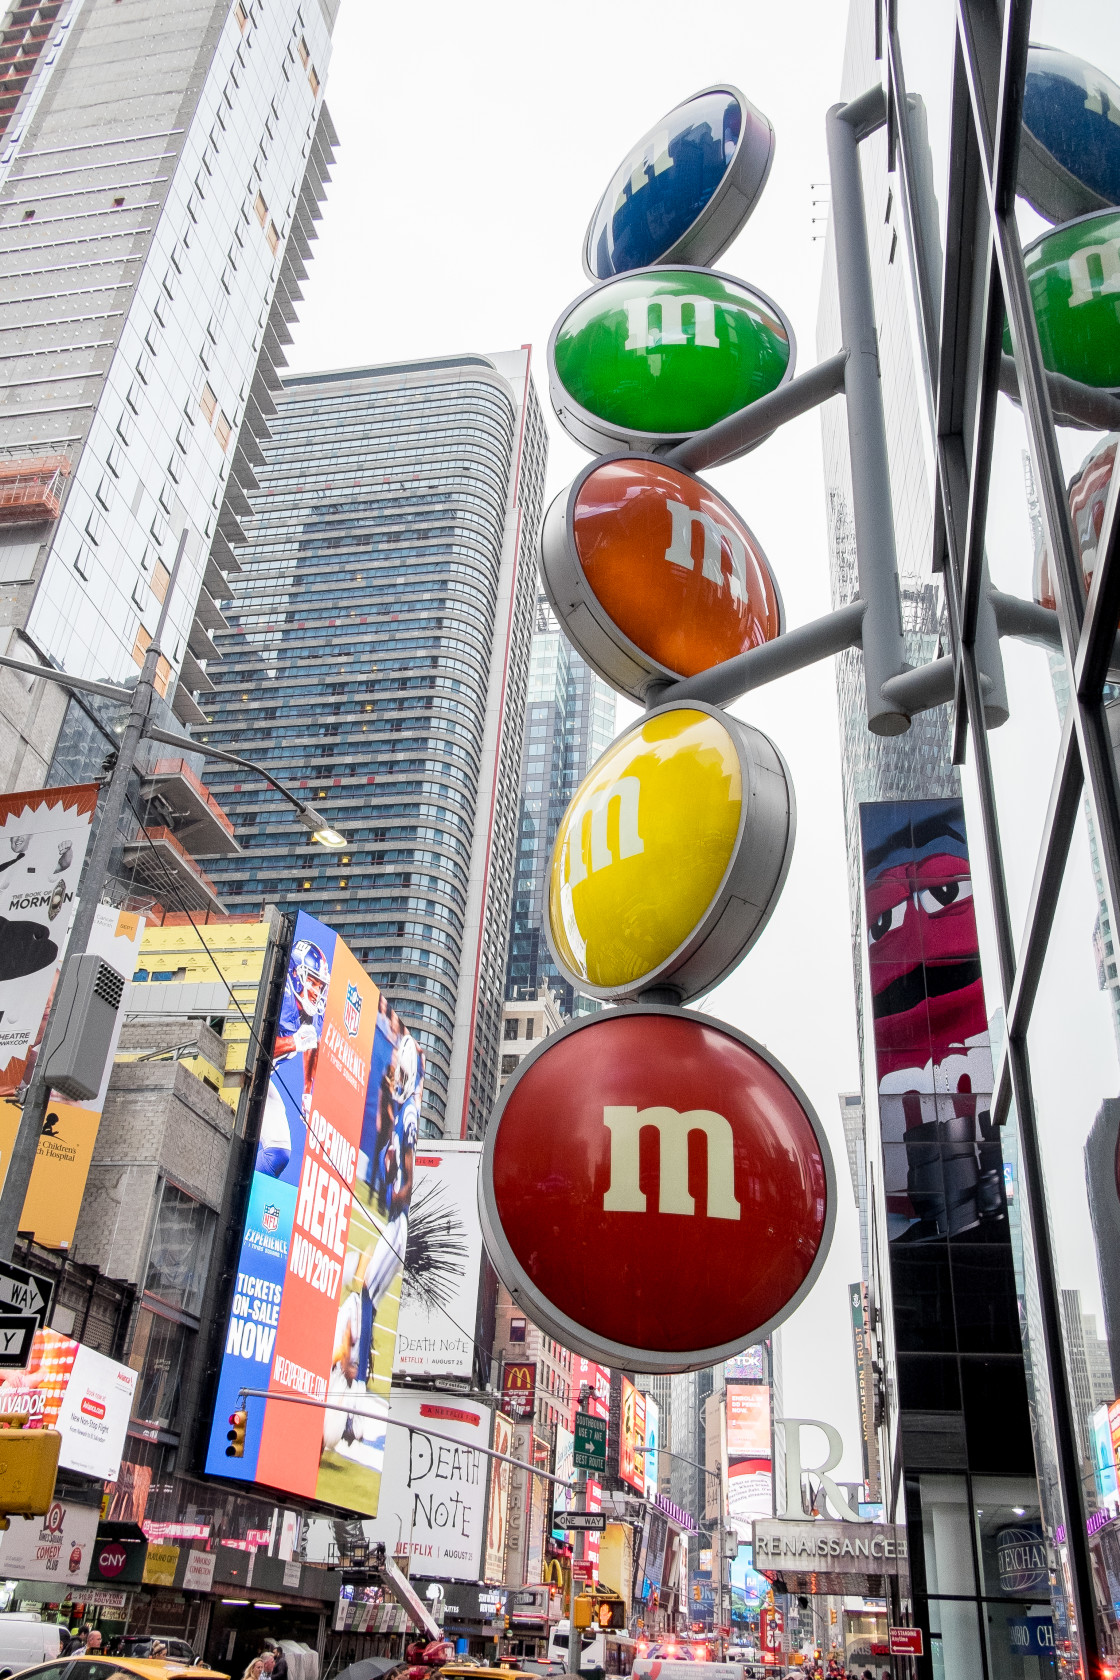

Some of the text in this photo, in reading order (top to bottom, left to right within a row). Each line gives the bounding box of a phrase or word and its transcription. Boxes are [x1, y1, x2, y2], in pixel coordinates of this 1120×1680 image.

[624, 294, 720, 351] m
[664, 498, 749, 606] m
[568, 775, 645, 890] m
[345, 1002, 358, 1033] NFL
[324, 1023, 366, 1087] EXPERIENCE
[42, 1140, 77, 1155] Children's
[46, 1148, 75, 1162] Hospital
[309, 1109, 356, 1184] OPENING
[603, 1105, 741, 1221] m
[297, 1155, 351, 1258] HERE
[263, 1214, 278, 1229] NFL
[245, 1230, 288, 1254] EXPERIENCE
[11, 1283, 38, 1310] WAY
[238, 1273, 282, 1304] TICKETS
[233, 1294, 280, 1326] ON-SALE
[226, 1317, 276, 1364] NOW
[399, 1334, 435, 1354] DEATH
[400, 1356, 423, 1364] NETFLIX
[854, 1327, 868, 1440] NORTHERN TRUST
[577, 1415, 606, 1431] SOUTHBOUND
[578, 1427, 603, 1442] USE 7 AVE
[407, 1428, 480, 1488] DEATH
[575, 1454, 604, 1469] BEST ROUTE
[775, 1418, 880, 1524] R
[412, 1490, 472, 1538] NOTE
[560, 1516, 601, 1526] ONE WAY
[36, 1545, 61, 1560] COMEDY
[394, 1541, 433, 1558] NETFLIX
[444, 1548, 468, 1561] AUGUST
[755, 1535, 897, 1558] RENAISSANCE
[46, 1559, 59, 1571] CLUB
[100, 1554, 126, 1567] CNY
